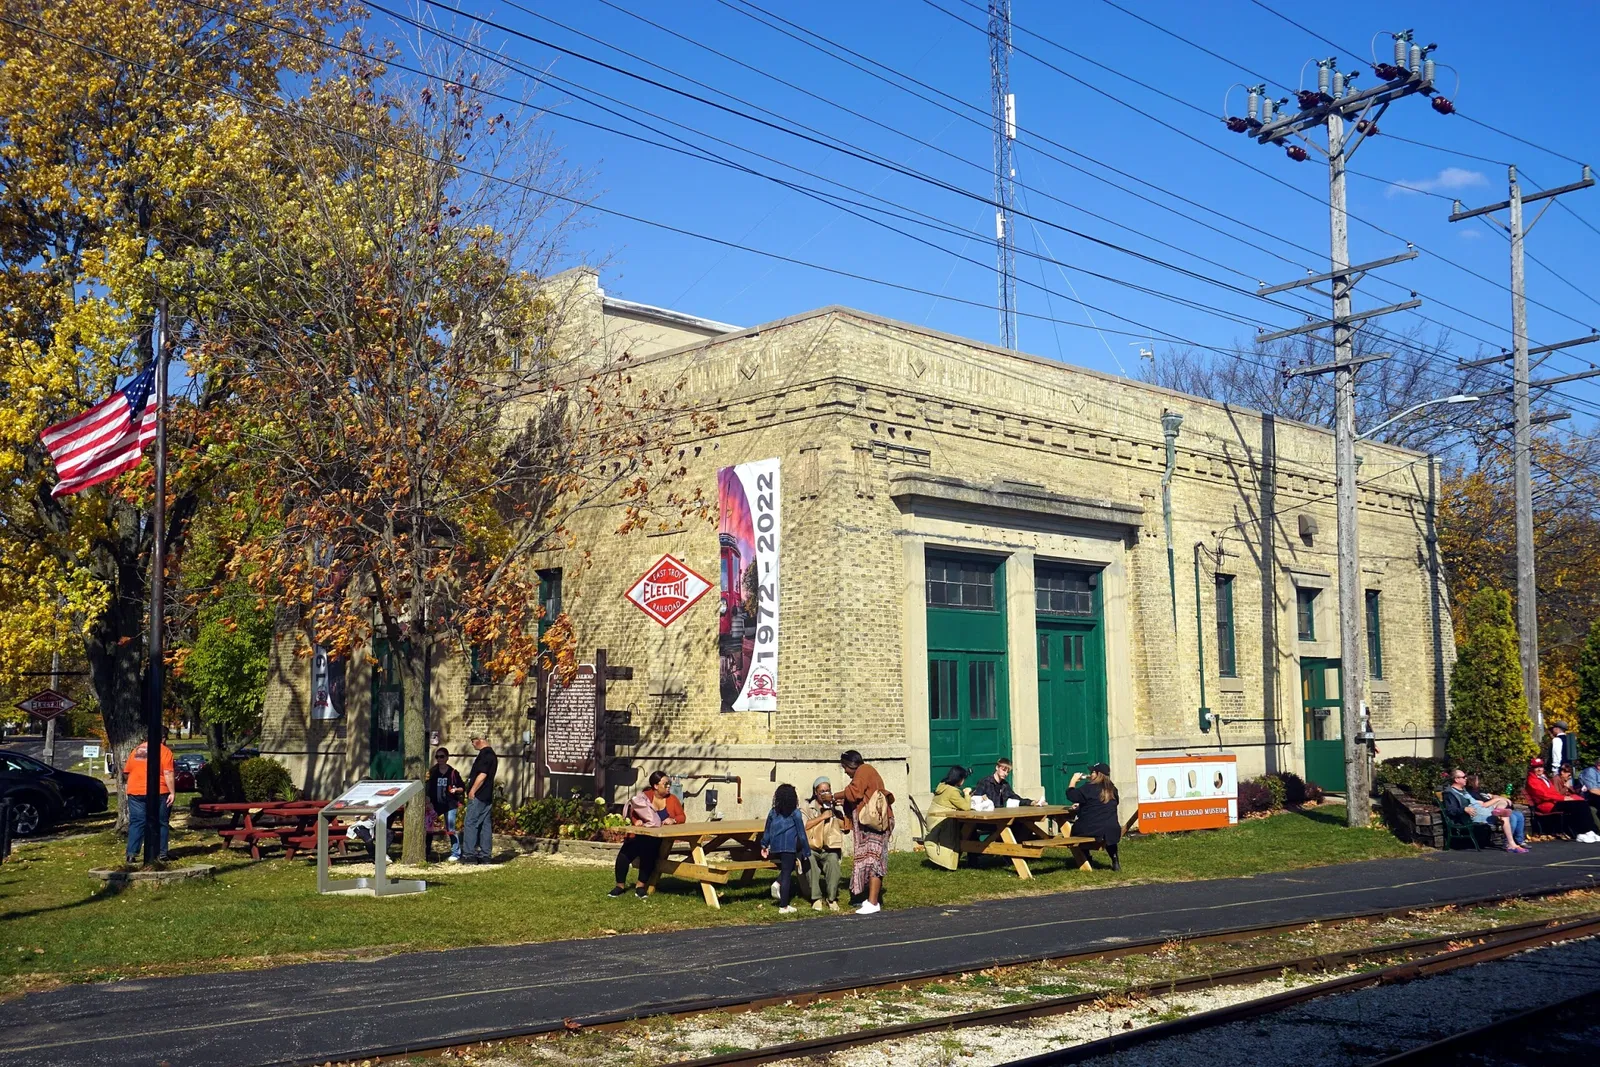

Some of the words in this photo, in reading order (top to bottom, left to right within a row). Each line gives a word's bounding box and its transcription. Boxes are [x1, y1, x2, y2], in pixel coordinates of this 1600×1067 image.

[757, 471, 775, 554] 2022
[652, 569, 667, 581] EAST
[667, 568, 683, 579] TROY
[643, 577, 689, 603] ELECTRIC
[653, 600, 681, 612] RAILROAD
[757, 583, 775, 663] 1972
[1142, 811, 1157, 820] EAST
[1159, 810, 1174, 818] TROY
[1175, 809, 1203, 817] RAILROAD
[1204, 807, 1227, 815] MUSEUM
